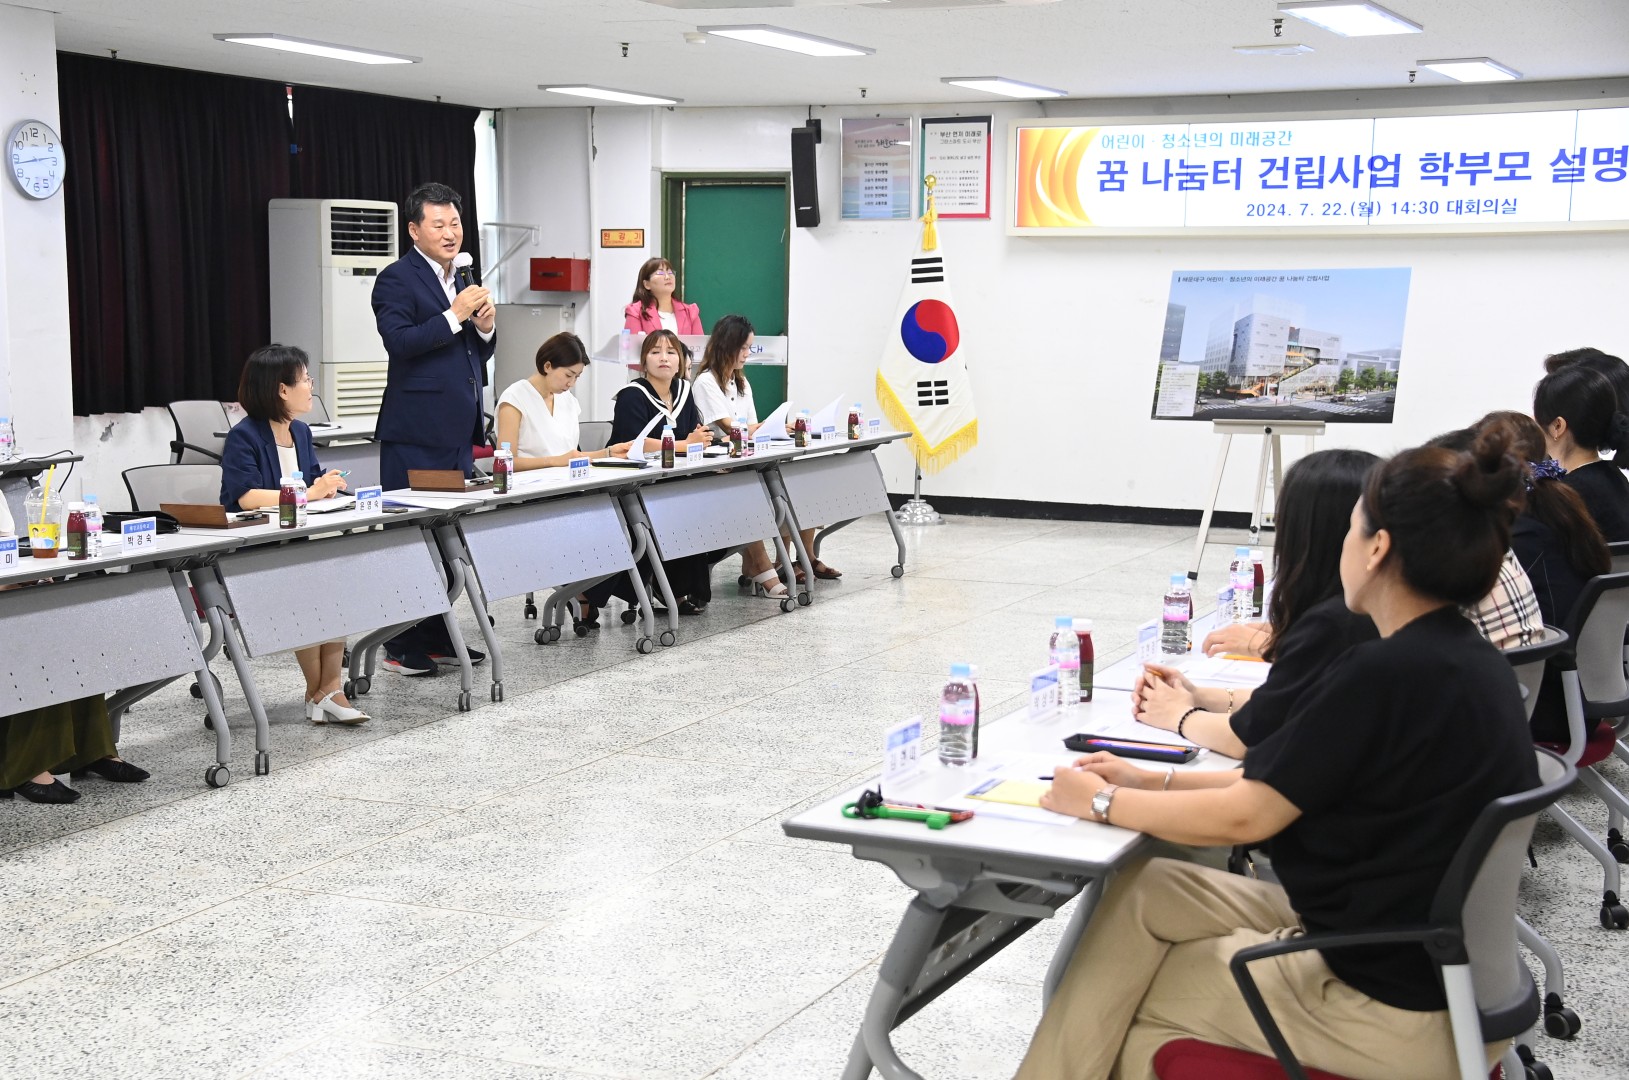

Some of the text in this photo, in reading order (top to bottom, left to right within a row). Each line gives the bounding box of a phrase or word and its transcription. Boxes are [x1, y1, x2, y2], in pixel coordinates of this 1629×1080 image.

[22, 131, 28, 141] 11
[30, 128, 38, 137] 12
[43, 134, 46, 142] 1
[1101, 130, 1293, 149] 어린이 청소년의 미래공간
[14, 141, 24, 150] 10
[48, 143, 54, 152] 2
[13, 154, 19, 164] 9
[52, 157, 57, 166] 3
[17, 168, 24, 178] 8
[1097, 145, 1629, 192] 꿈 나눔터 건립사업 학부모 설명
[49, 170, 54, 179] 4
[25, 178, 30, 187] 7
[43, 179, 49, 188] 5
[34, 183, 40, 192] 6
[1246, 203, 1292, 217] 2024.
[1300, 203, 1314, 216] 7.
[1391, 201, 1439, 215] 14:30
[1447, 198, 1518, 216] 대회의실
